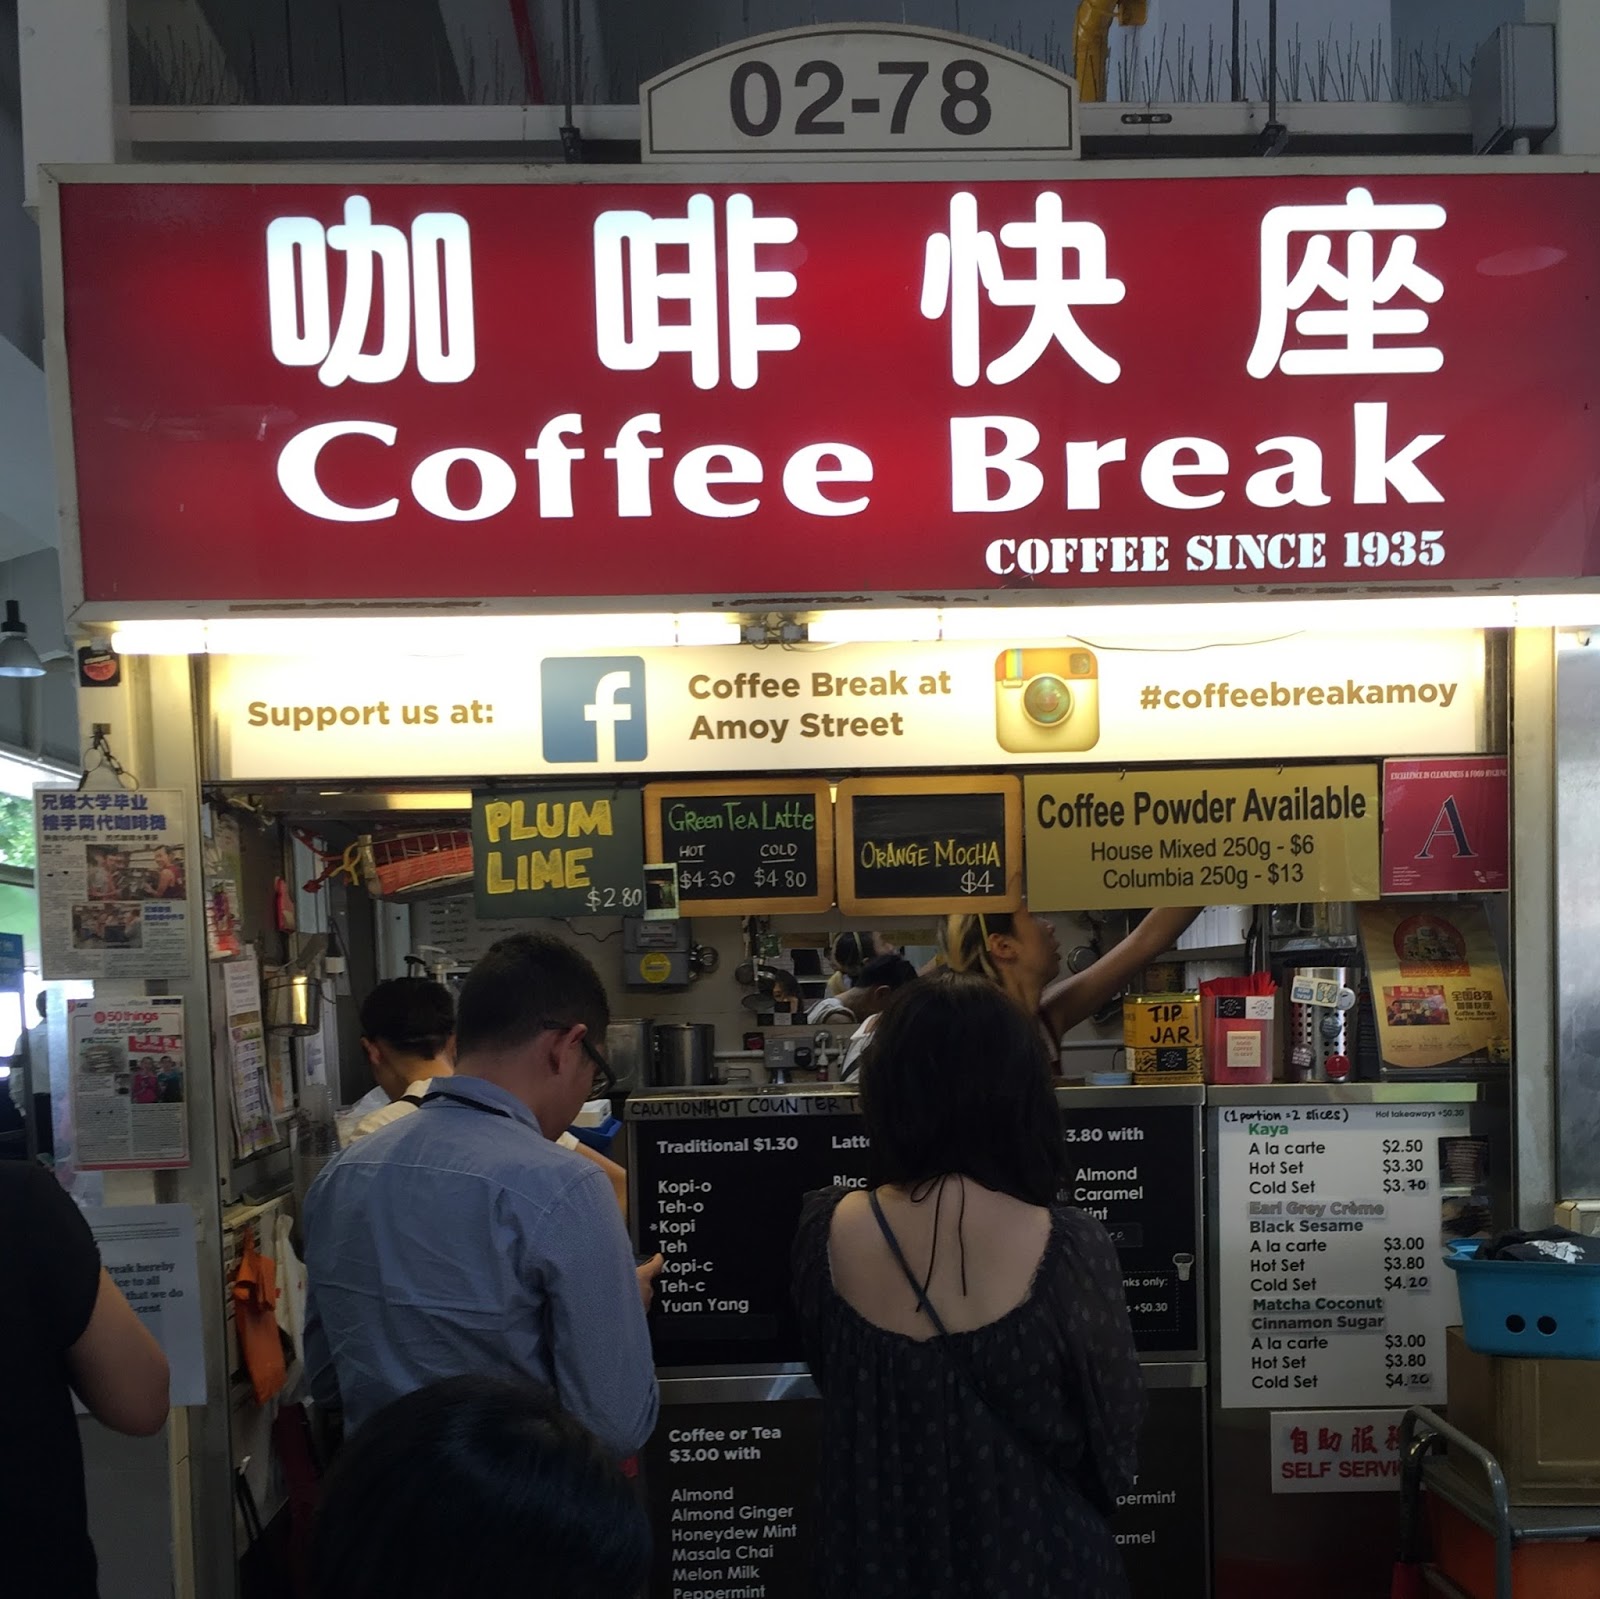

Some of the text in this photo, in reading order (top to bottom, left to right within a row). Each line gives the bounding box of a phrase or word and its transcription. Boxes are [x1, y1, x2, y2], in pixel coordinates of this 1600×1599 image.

[729, 58, 992, 137] 02-78
[266, 187, 1448, 389] 咖啡快座
[276, 401, 1446, 522] Coffee Break
[985, 530, 1446, 576] COFFEE SINCE 1935
[688, 670, 952, 700] Coffee Break at
[1140, 679, 1458, 710] #coffeebreakamoy
[247, 699, 495, 732] Support us at:
[689, 713, 904, 743] Amoy Street
[1037, 785, 1366, 829] Coffee Powder Available
[485, 799, 613, 843] PLUM
[1414, 795, 1479, 859] A
[679, 843, 798, 857] HOT COLD
[860, 838, 1001, 869] ORANGE MOCHA
[1091, 834, 1315, 862] House Mixed 250g $6
[487, 847, 593, 895] LIME
[1103, 863, 1304, 889] Columbia 250g $13
[960, 869, 995, 895] $4
[585, 885, 642, 913] $2.80
[106, 1011, 122, 1022] 50
[124, 1010, 160, 1025] things
[1147, 1004, 1183, 1023] TIP
[1149, 1026, 1192, 1045] JAR
[748, 1097, 841, 1114] COUNTER
[1391, 1110, 1436, 1119] takeaways
[1065, 1127, 1145, 1142] 3.80 with
[1248, 1123, 1289, 1137] Kaya
[657, 1137, 799, 1154] Traditional $1.30
[1249, 1139, 1423, 1155] A la carte $2.50
[1075, 1167, 1138, 1182] Almond
[1249, 1159, 1424, 1175] Hot Set $3.30
[658, 1180, 712, 1197] Kopi-o
[832, 1175, 868, 1188] Blac
[1249, 1179, 1426, 1194] Cold Set $3.70
[1074, 1186, 1144, 1201] Caramel
[658, 1200, 704, 1214] Teh-o
[1083, 1207, 1109, 1220] int
[1249, 1201, 1283, 1215] Earl
[1286, 1201, 1326, 1218] Grey
[1250, 1220, 1364, 1233] Black Sesame
[659, 1239, 688, 1254] Teh
[1250, 1237, 1425, 1253] A la carte $3.00
[136, 1263, 175, 1273] hereby
[661, 1259, 714, 1276] Kopi-c
[1250, 1257, 1425, 1273] Hot Set $3.80
[132, 1278, 144, 1286] to
[146, 1276, 160, 1285] all
[660, 1280, 706, 1293] Teh-c
[1142, 1276, 1169, 1289] only:
[1250, 1276, 1428, 1292] Cold Set $4.20
[126, 1291, 148, 1300] that
[168, 1288, 184, 1298] do
[661, 1298, 749, 1314] Yuan Yang
[1133, 1302, 1168, 1313] +$0.30
[1253, 1297, 1383, 1311] Matcha Coconut
[1251, 1316, 1384, 1331] Cinnamon Sugar
[1251, 1335, 1426, 1350] A la carte $3.00
[1251, 1354, 1426, 1370] Hot Set $3.80
[1252, 1373, 1429, 1389] Cold Set $4.20
[668, 1426, 782, 1442] Coffee or Tea
[669, 1447, 761, 1463] $3.00 with
[1281, 1460, 1400, 1479] SELF SERVI
[671, 1487, 734, 1502] Almond
[671, 1506, 794, 1522] Almond Ginger
[672, 1524, 798, 1543] Honeydew Mint
[672, 1545, 774, 1562] Masala Chai
[672, 1565, 760, 1582] Melon Milk
[673, 1585, 766, 1599] Peppermint
